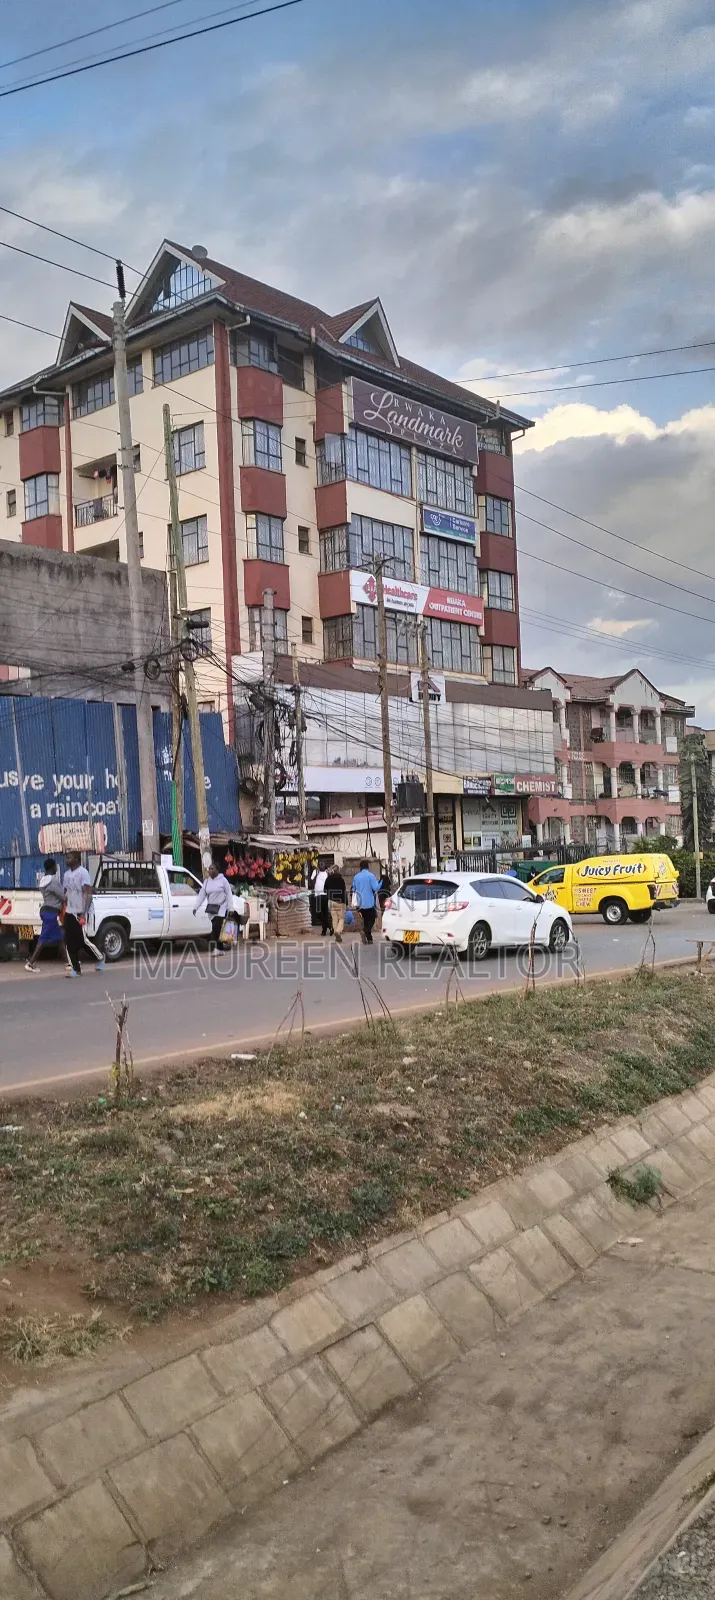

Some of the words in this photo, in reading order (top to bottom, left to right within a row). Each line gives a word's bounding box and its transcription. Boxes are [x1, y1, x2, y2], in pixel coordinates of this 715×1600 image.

[363, 391, 464, 448] Landmark
[394, 398, 446, 425] RWAKA
[400, 428, 458, 454] PLAZA
[382, 584, 418, 601] Healthcare
[428, 602, 463, 616] OUTPATIENT
[463, 608, 483, 620] CENTRE
[53, 774, 94, 797] your
[516, 780, 556, 793] CHEMIST
